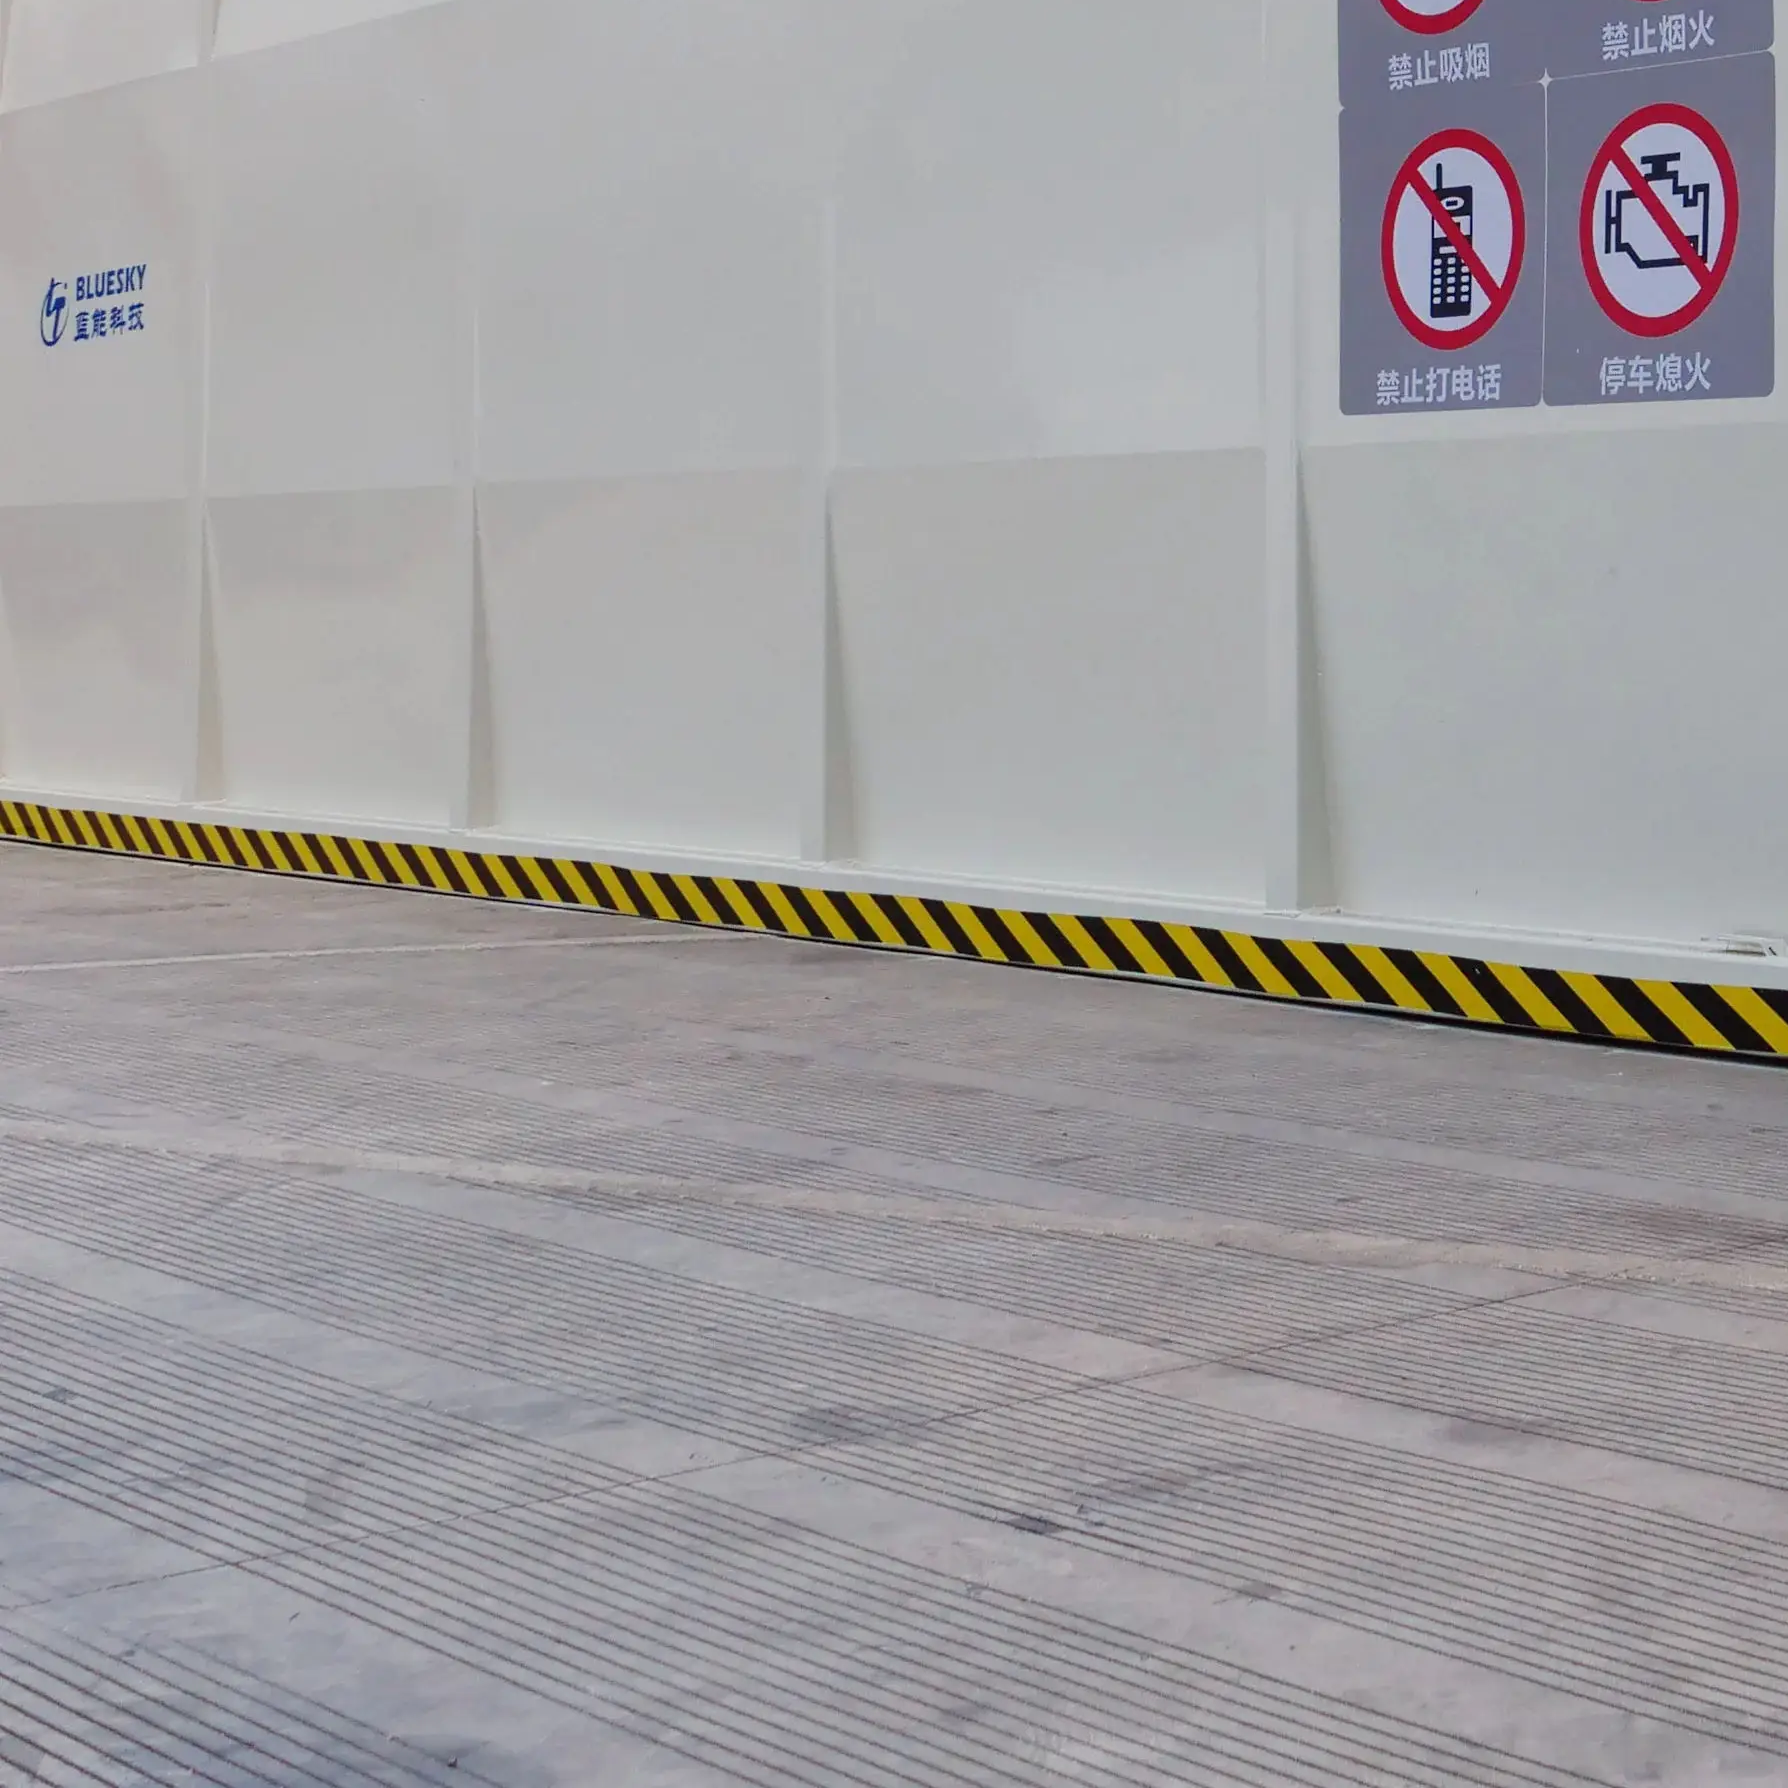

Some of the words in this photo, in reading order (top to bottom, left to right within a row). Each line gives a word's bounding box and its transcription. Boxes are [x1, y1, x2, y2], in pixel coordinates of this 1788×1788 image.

[1601, 8, 1716, 61] 禁止烟火
[1387, 41, 1491, 92] 禁止吸烟
[76, 264, 147, 301] BLUESKY
[1376, 362, 1502, 407] 禁止打电话
[1599, 351, 1712, 396] 停车熄火
